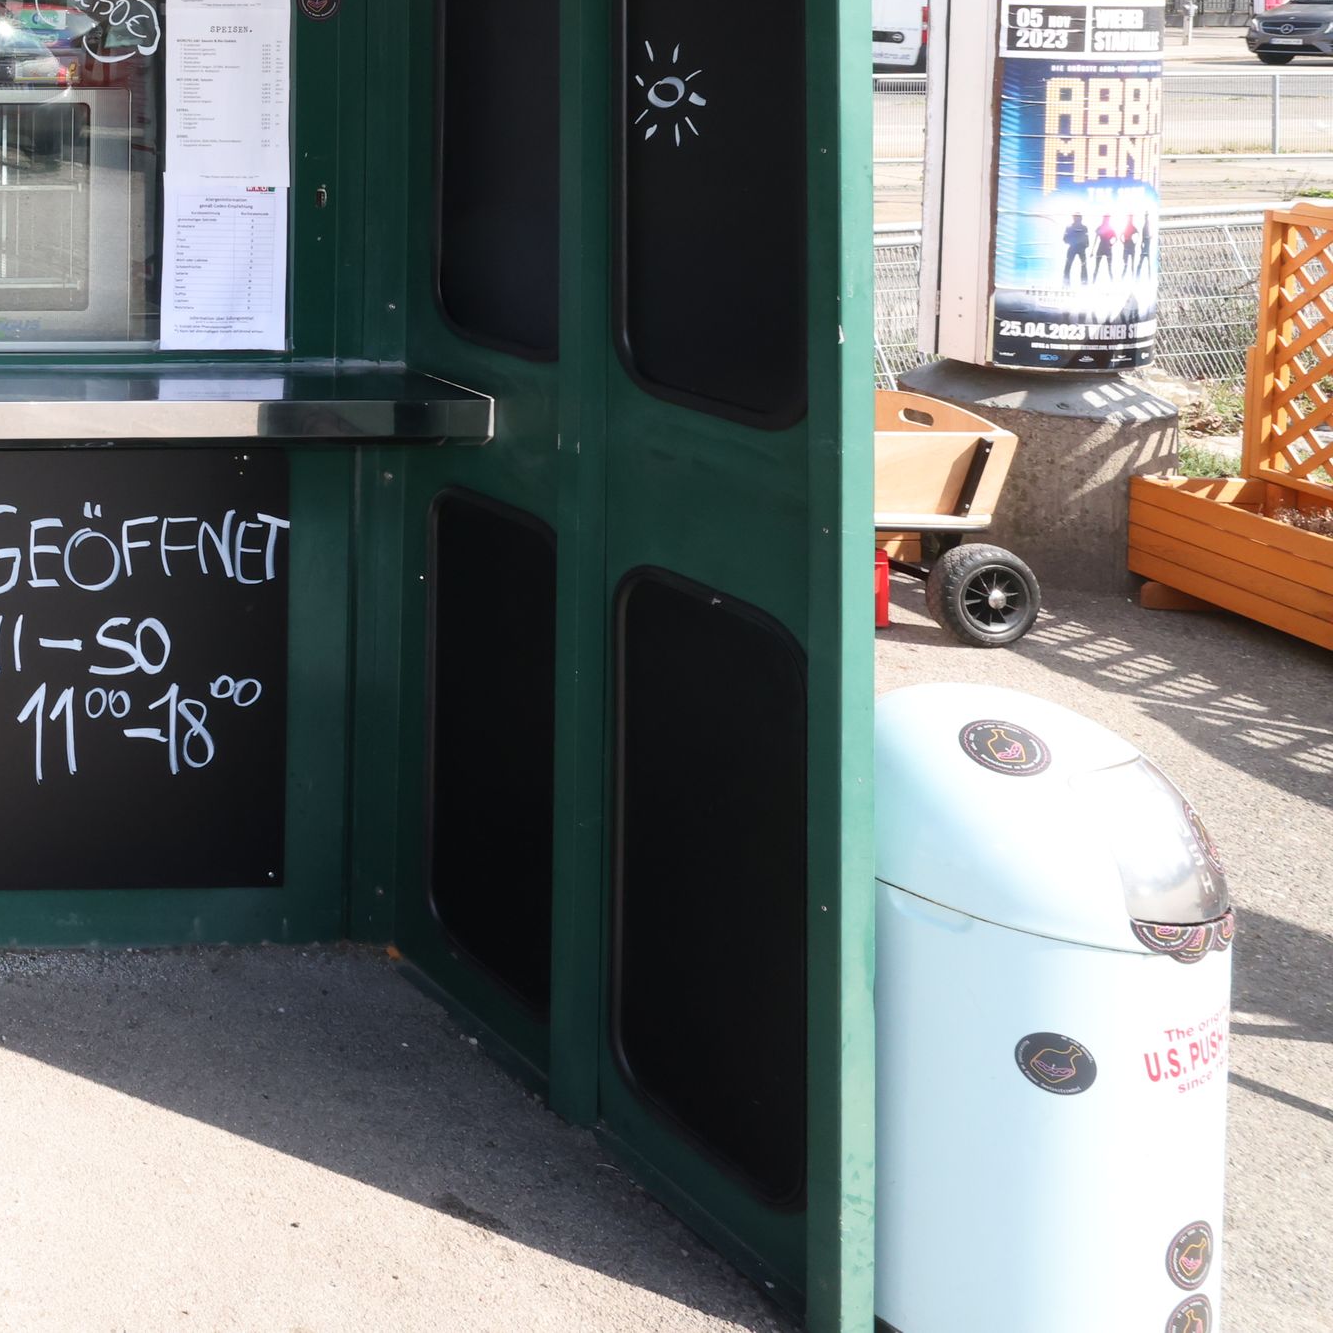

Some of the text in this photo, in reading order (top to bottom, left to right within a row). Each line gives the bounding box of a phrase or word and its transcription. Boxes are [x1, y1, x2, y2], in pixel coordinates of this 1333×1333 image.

[1016, 7, 1044, 27] 05
[209, 25, 254, 34] SPEISEN.
[1015, 29, 1069, 49] 2023
[999, 320, 1086, 341] 25.04.2023
[1163, 1027, 1194, 1043] The
[1143, 1047, 1187, 1083] U.S.
[1177, 1070, 1213, 1094] since
